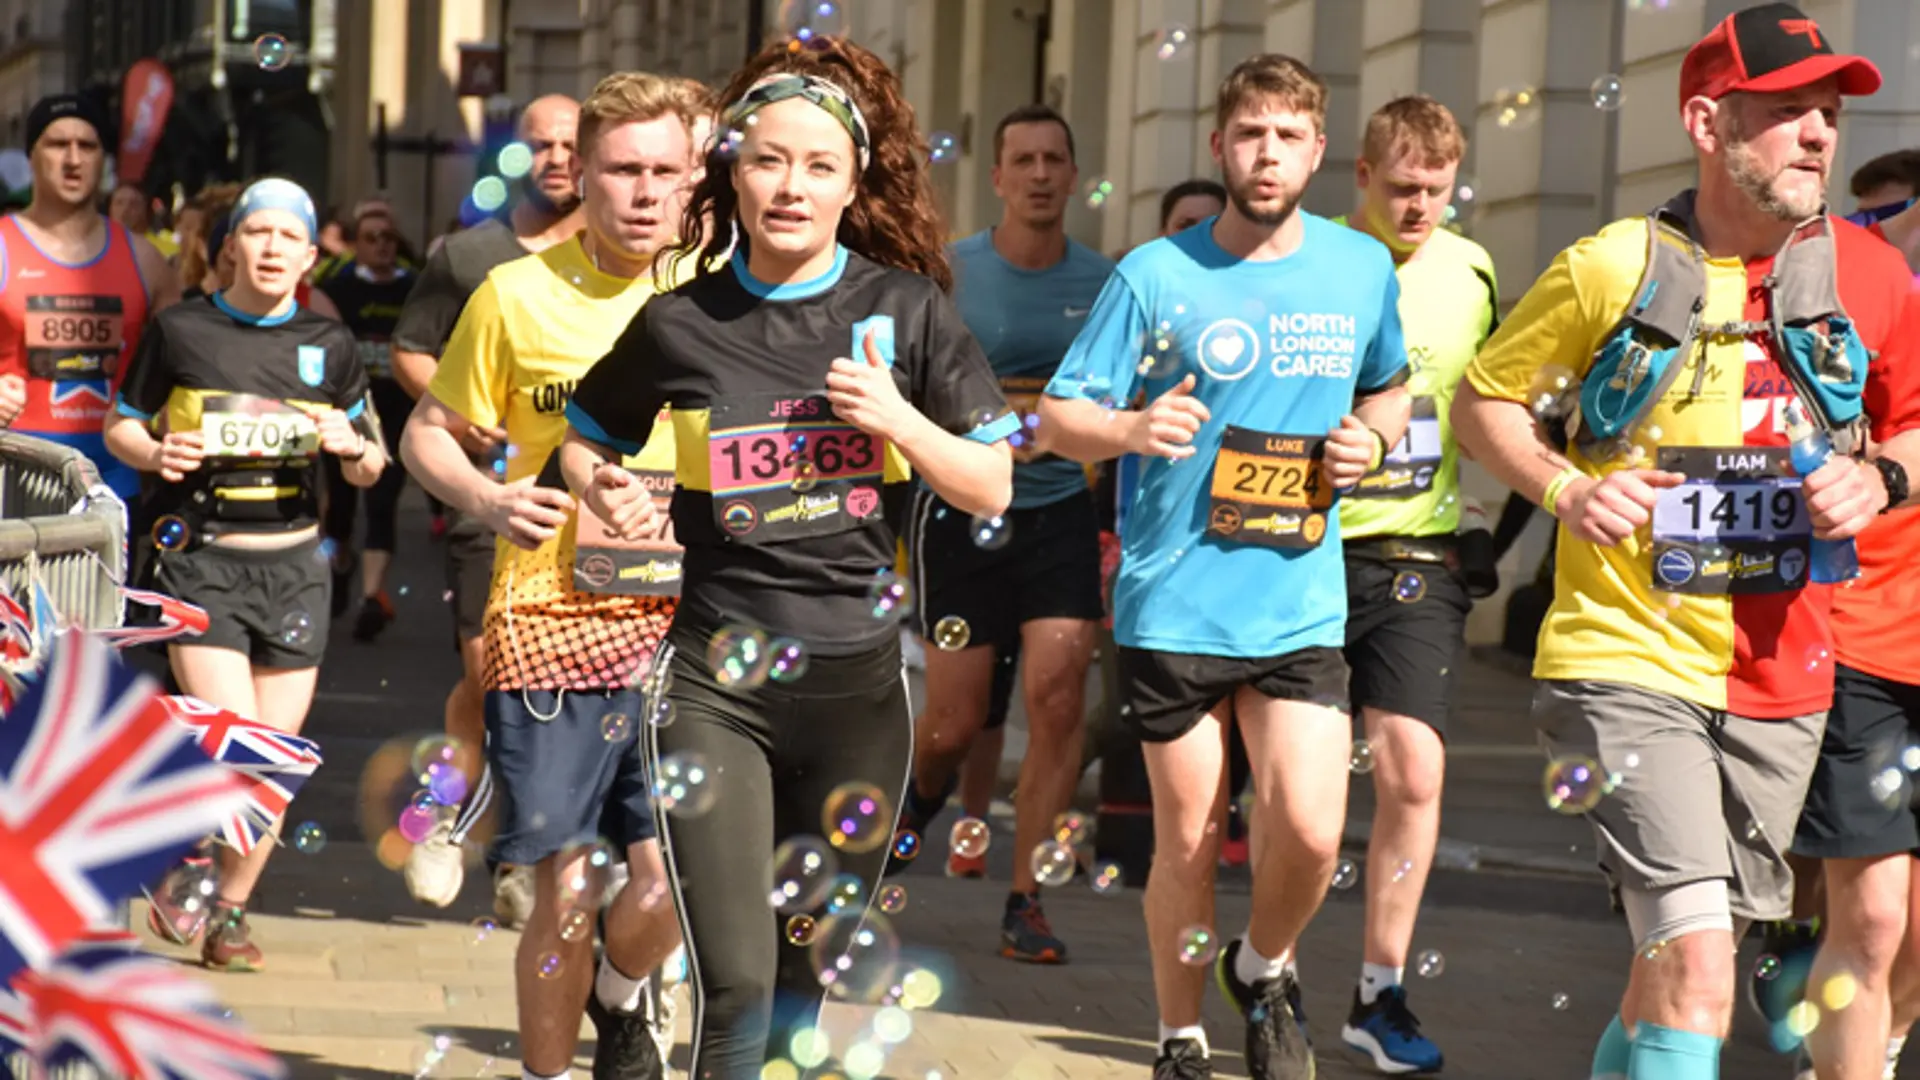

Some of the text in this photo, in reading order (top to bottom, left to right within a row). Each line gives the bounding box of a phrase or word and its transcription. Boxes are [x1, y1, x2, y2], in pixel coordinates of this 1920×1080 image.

[42, 317, 111, 342] 8905
[1269, 313, 1355, 335] NORTH
[1269, 335, 1355, 353] LONDON
[1270, 353, 1353, 378] CARES
[533, 380, 574, 412] LON
[769, 399, 819, 418] JESS
[220, 421, 302, 449] 6704
[1265, 438, 1305, 454] LUKE
[1716, 454, 1767, 470] LIAM
[1233, 461, 1319, 498] 2724
[1682, 489, 1797, 531] 1419
